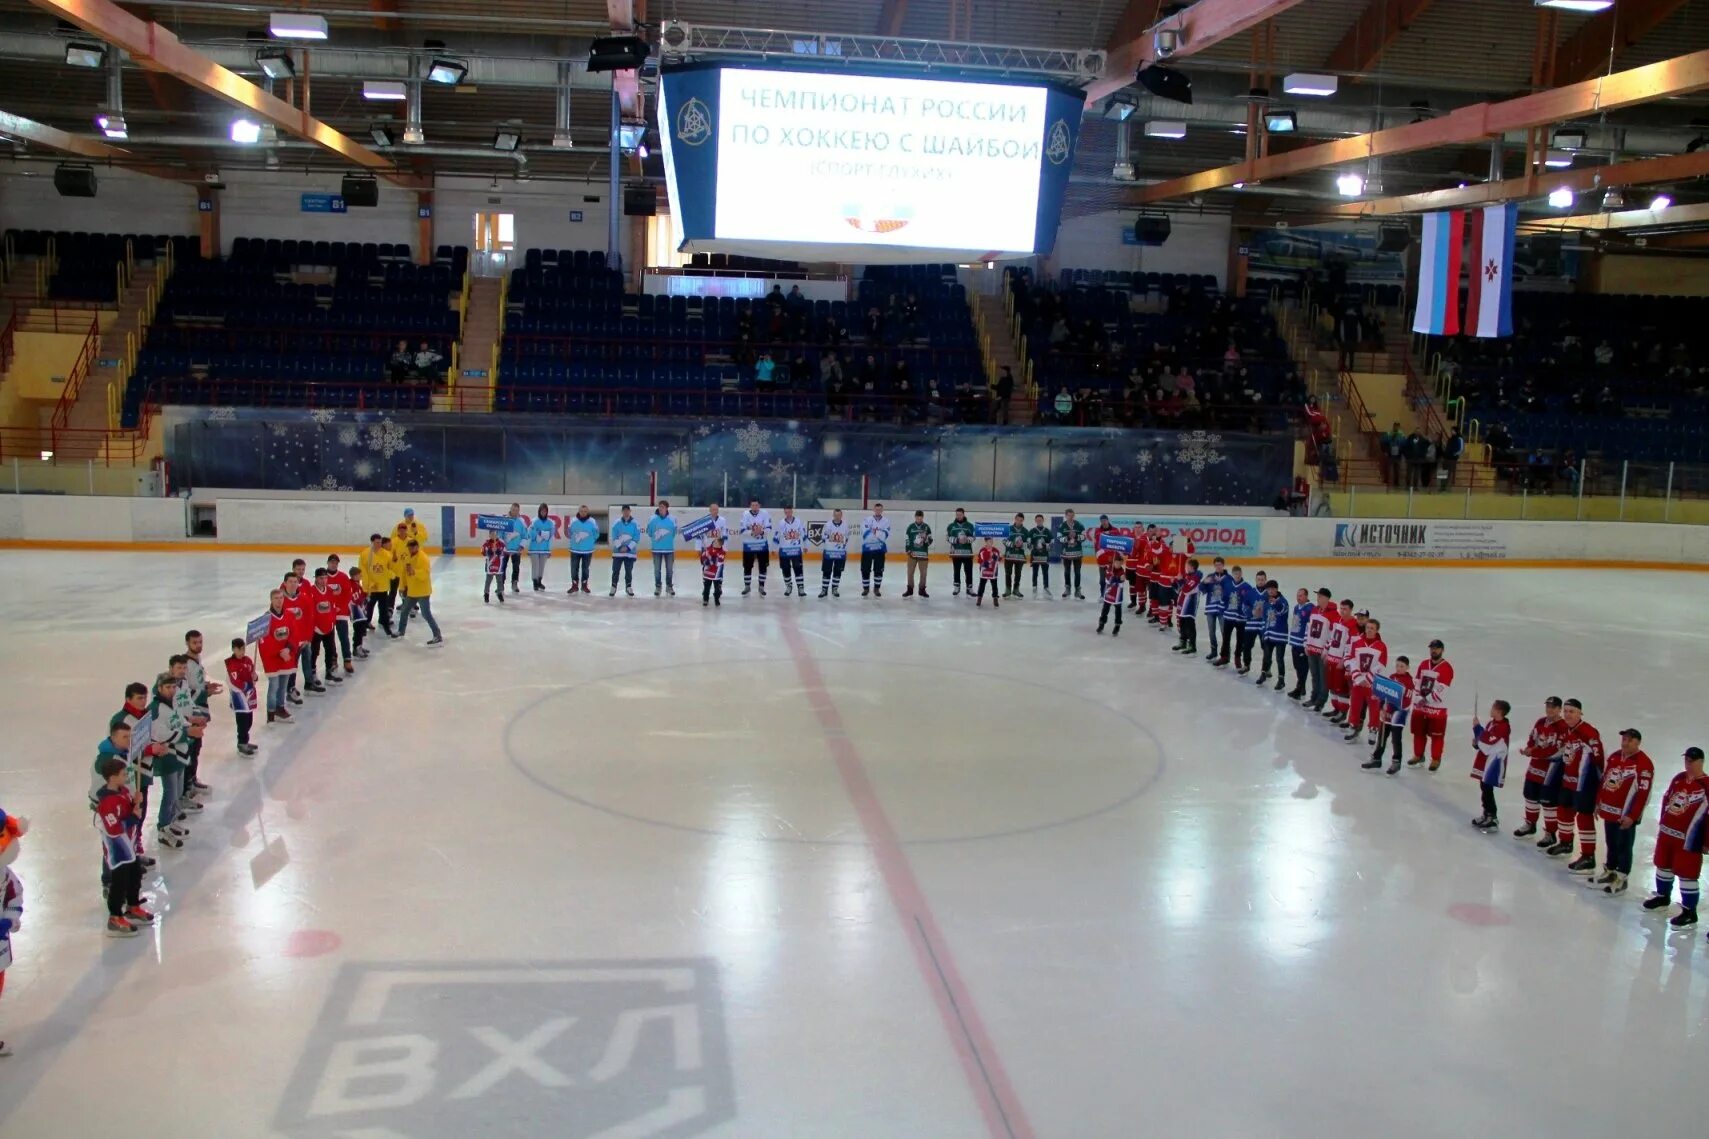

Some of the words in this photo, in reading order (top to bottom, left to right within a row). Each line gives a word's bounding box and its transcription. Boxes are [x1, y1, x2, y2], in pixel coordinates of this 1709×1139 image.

[741, 88, 912, 116] ЧЕМПИОНАТ
[921, 98, 1026, 123] РОССИИ
[732, 124, 769, 145] ПО
[779, 127, 890, 152] ХОККЕЮ
[899, 132, 912, 153] С
[1360, 524, 1427, 544] ИСТОЧНИК
[1375, 683, 1399, 699] МОСКВА
[306, 1003, 702, 1119] ВХЛ
